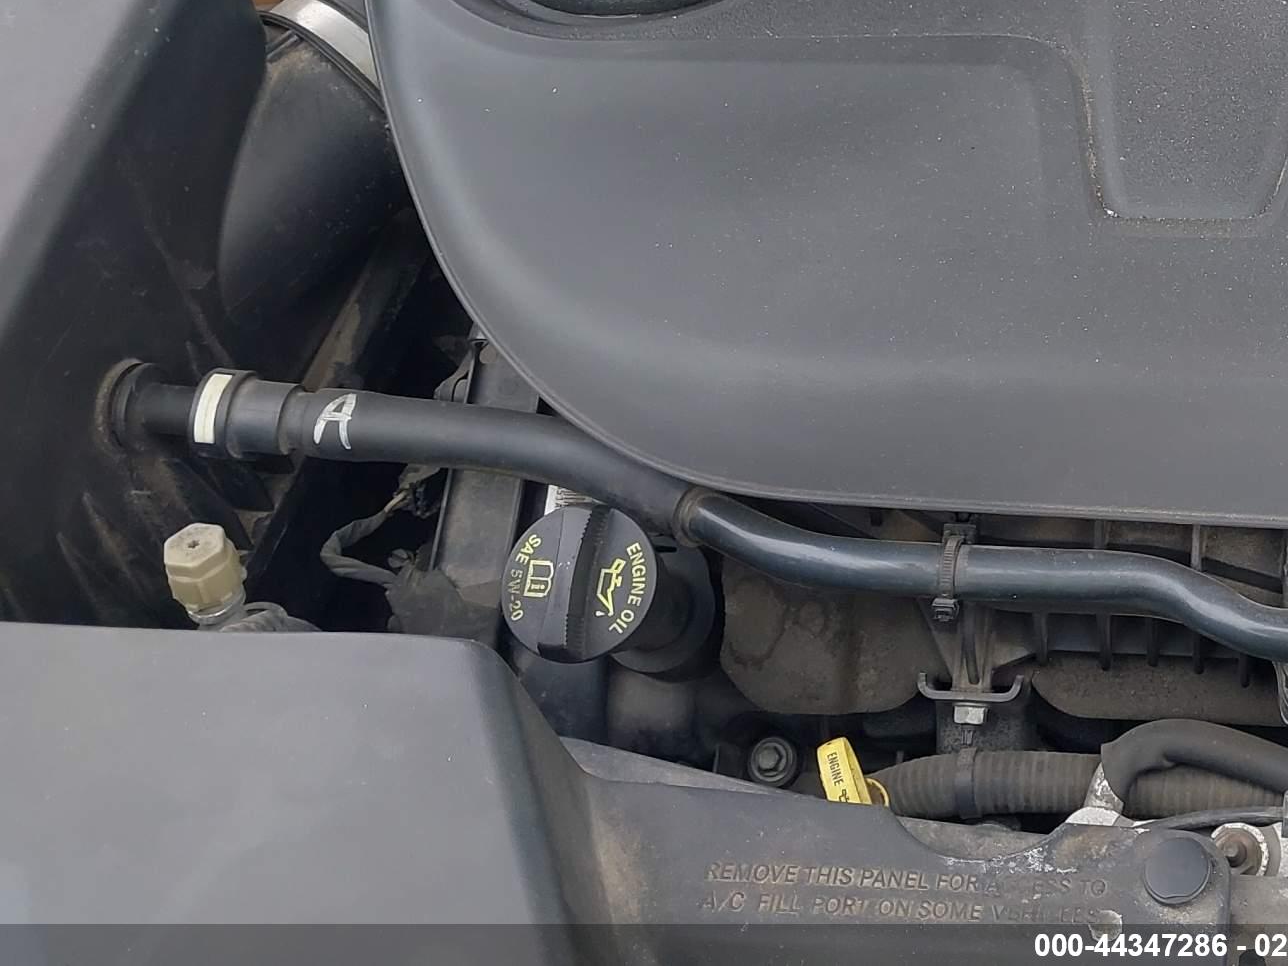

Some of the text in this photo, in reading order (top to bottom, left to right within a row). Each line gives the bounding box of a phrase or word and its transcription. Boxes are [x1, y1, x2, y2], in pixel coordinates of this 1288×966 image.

[313, 393, 358, 450] A
[507, 534, 542, 622] SAE 5W-20
[608, 542, 648, 635] ENGINE OIL
[826, 751, 845, 787] ENGINE
[705, 860, 800, 884] REMOVE
[804, 865, 854, 886] THIS
[859, 868, 930, 892] PANEL
[935, 872, 979, 893] FOR
[1080, 878, 1108, 897] TO
[701, 890, 746, 913] A/C
[757, 892, 802, 915] FILL
[812, 896, 868, 916] PORT
[878, 898, 914, 919] ON
[917, 900, 985, 922] SOME
